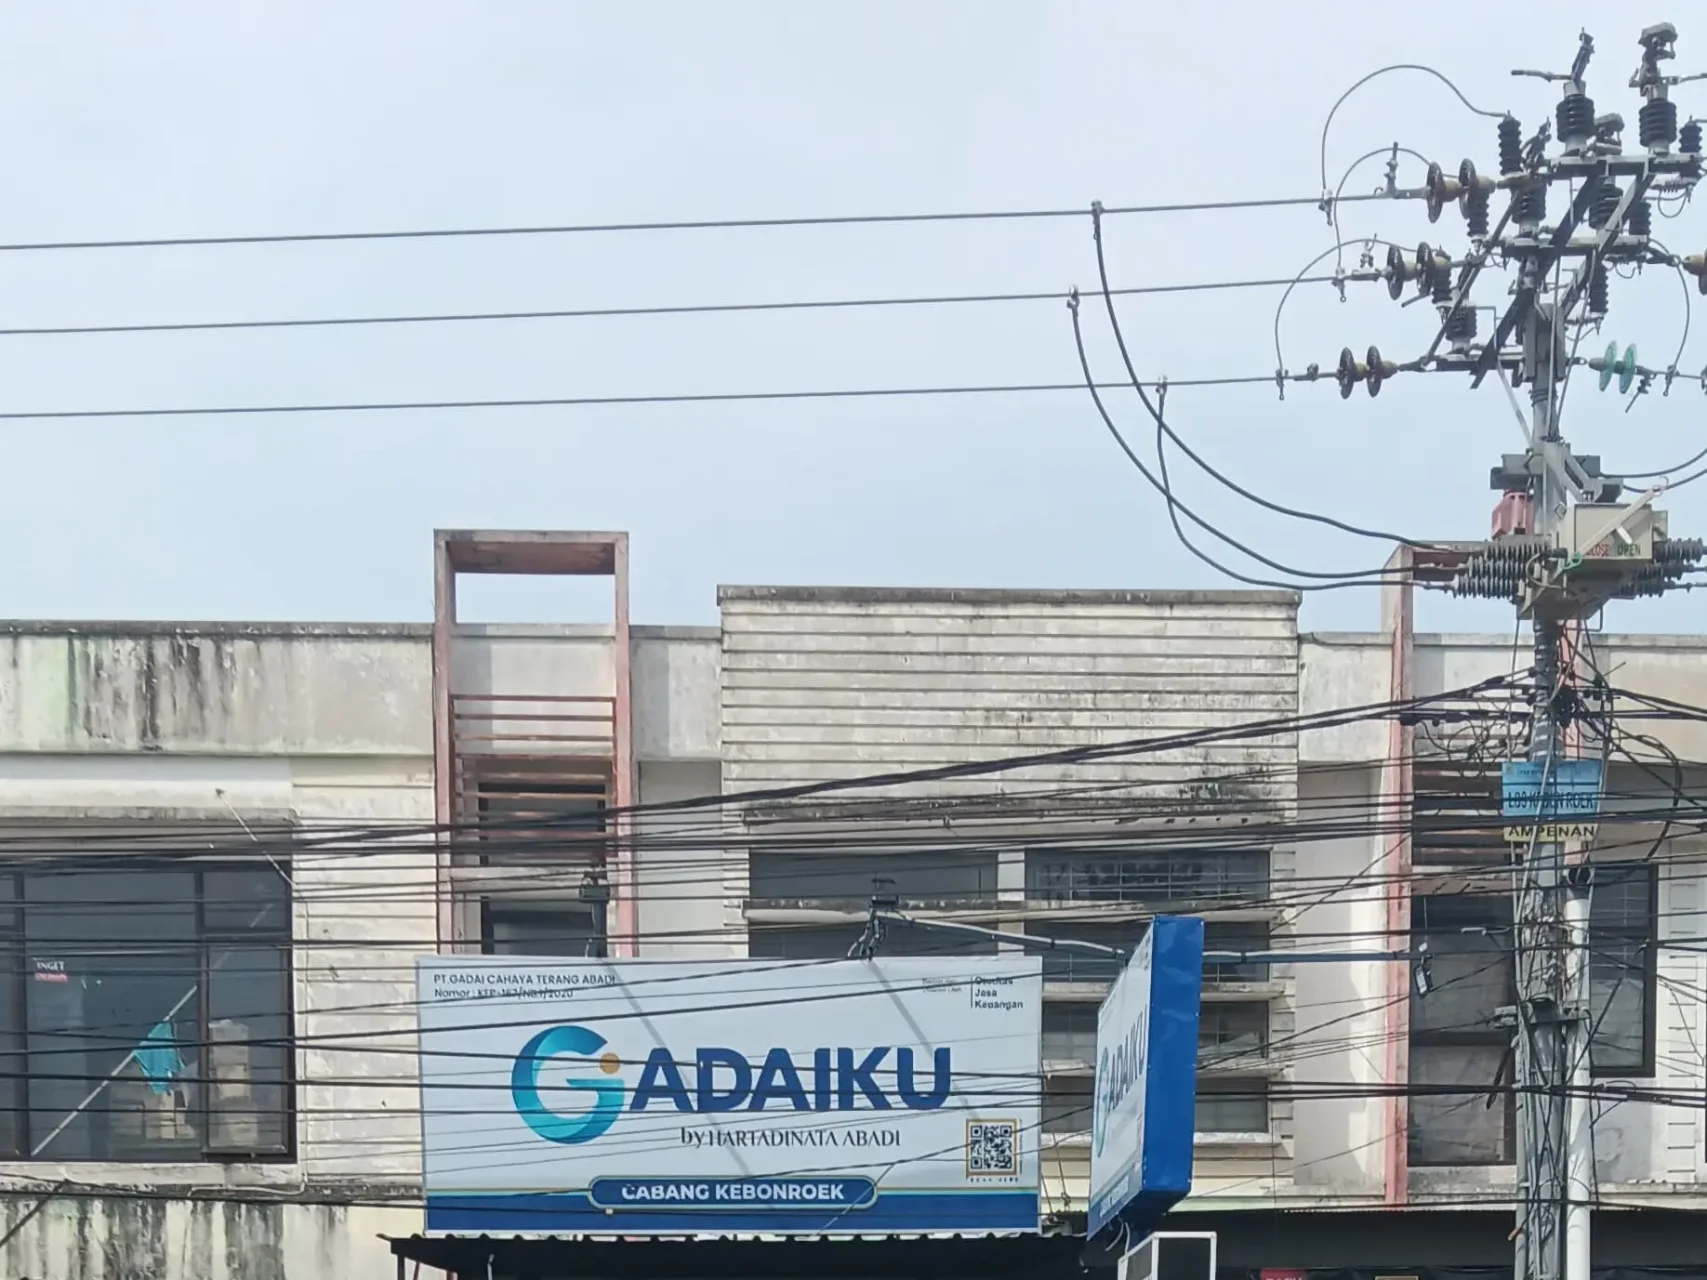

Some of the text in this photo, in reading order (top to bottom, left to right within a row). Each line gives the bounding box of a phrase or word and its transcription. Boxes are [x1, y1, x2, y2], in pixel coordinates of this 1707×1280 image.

[1508, 825, 1595, 837] AMPENAN
[486, 974, 533, 984] CAHAYA
[537, 974, 579, 984] TERANG
[582, 974, 615, 984] ABADI
[434, 988, 470, 998] Nomor
[975, 989, 997, 997] Jasa
[975, 1000, 1024, 1010] Keuangan
[512, 1025, 952, 1145] GADAIKU
[681, 1127, 900, 1148] by HARTADINATA ABADI
[622, 1184, 844, 1200] CABANG KEBONROEK
